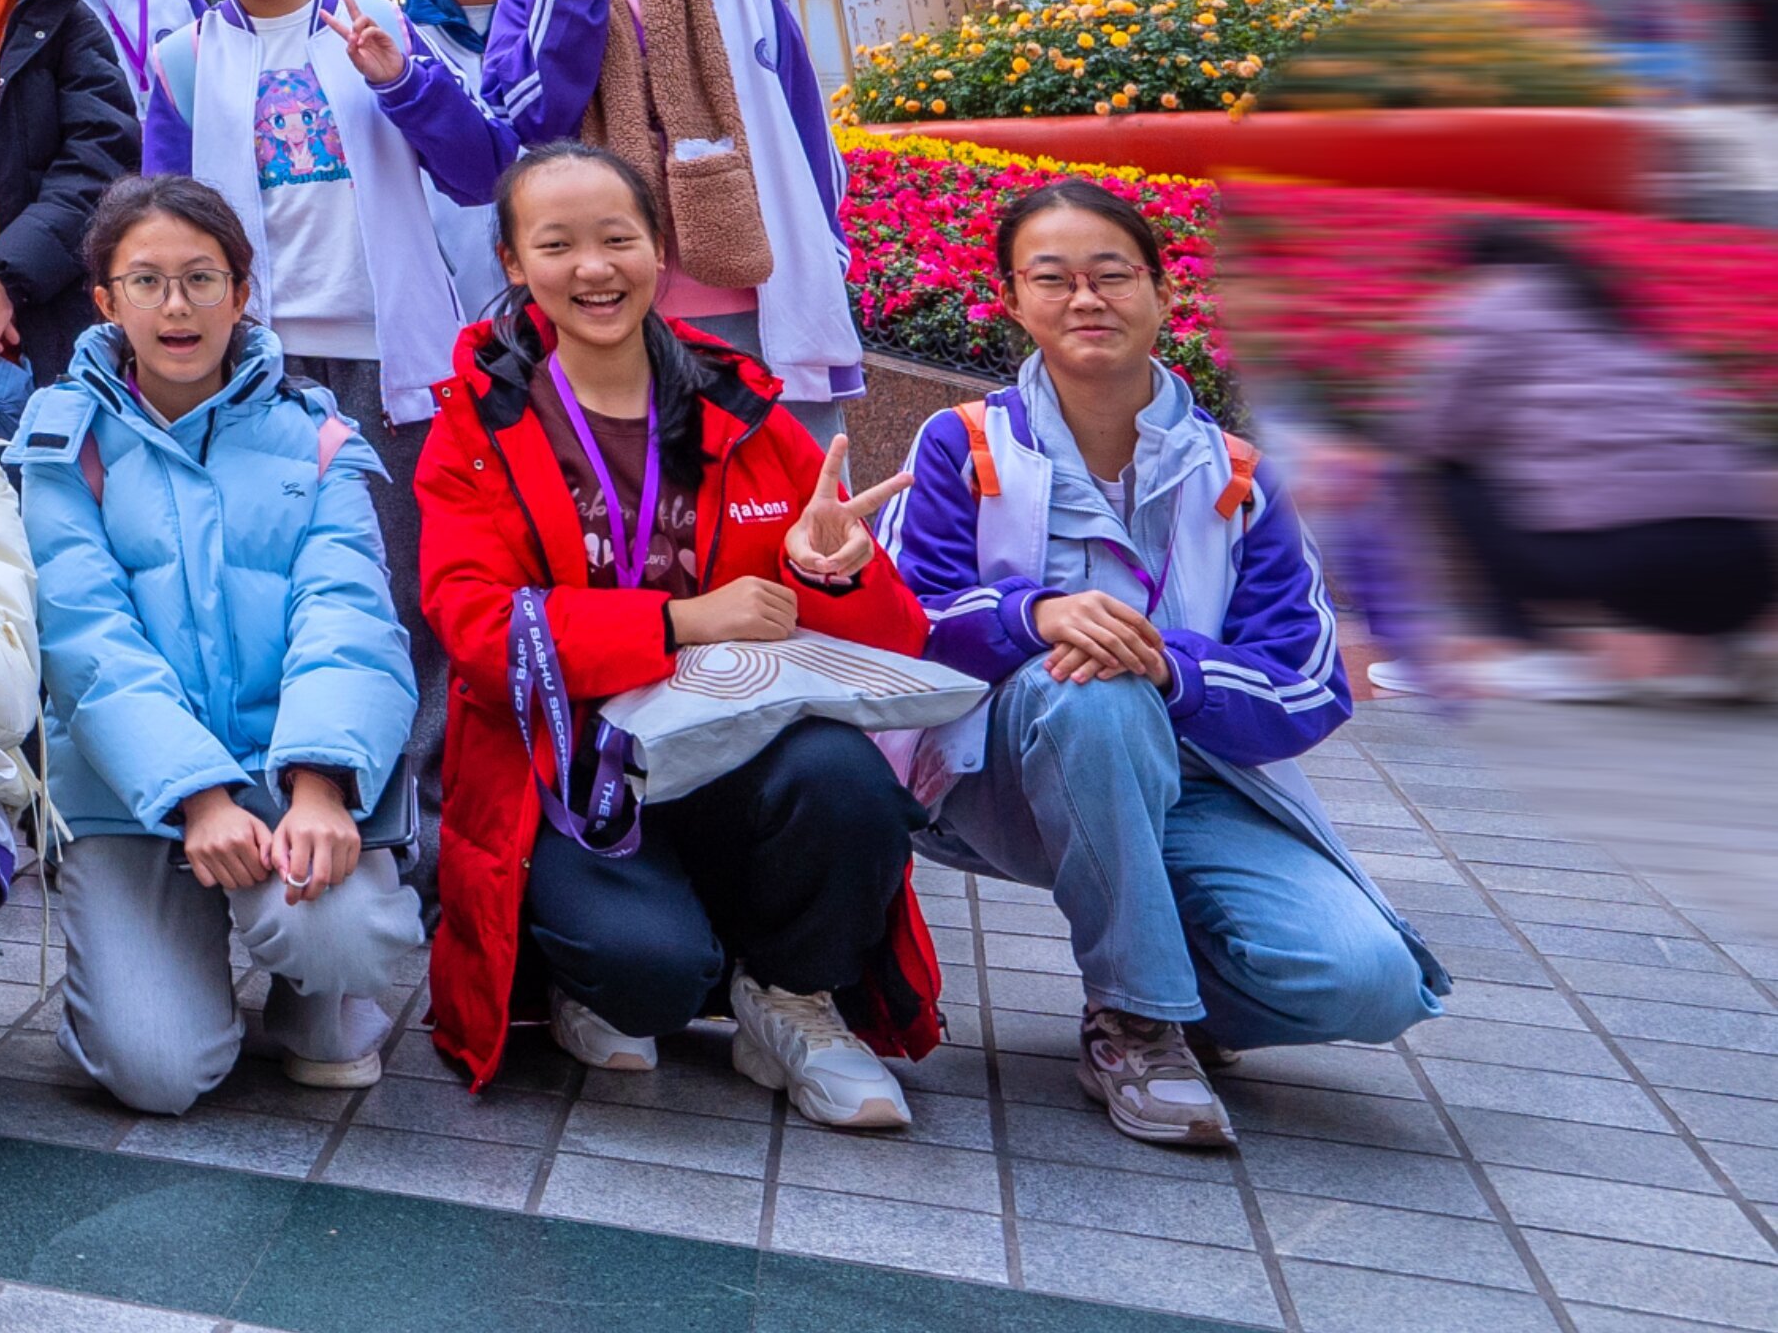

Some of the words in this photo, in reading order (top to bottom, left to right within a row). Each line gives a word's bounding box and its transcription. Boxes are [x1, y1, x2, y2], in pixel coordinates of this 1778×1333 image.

[522, 600, 537, 622] OF
[529, 627, 555, 691] BASHU
[514, 685, 525, 712] OF
[598, 780, 616, 817] THE
